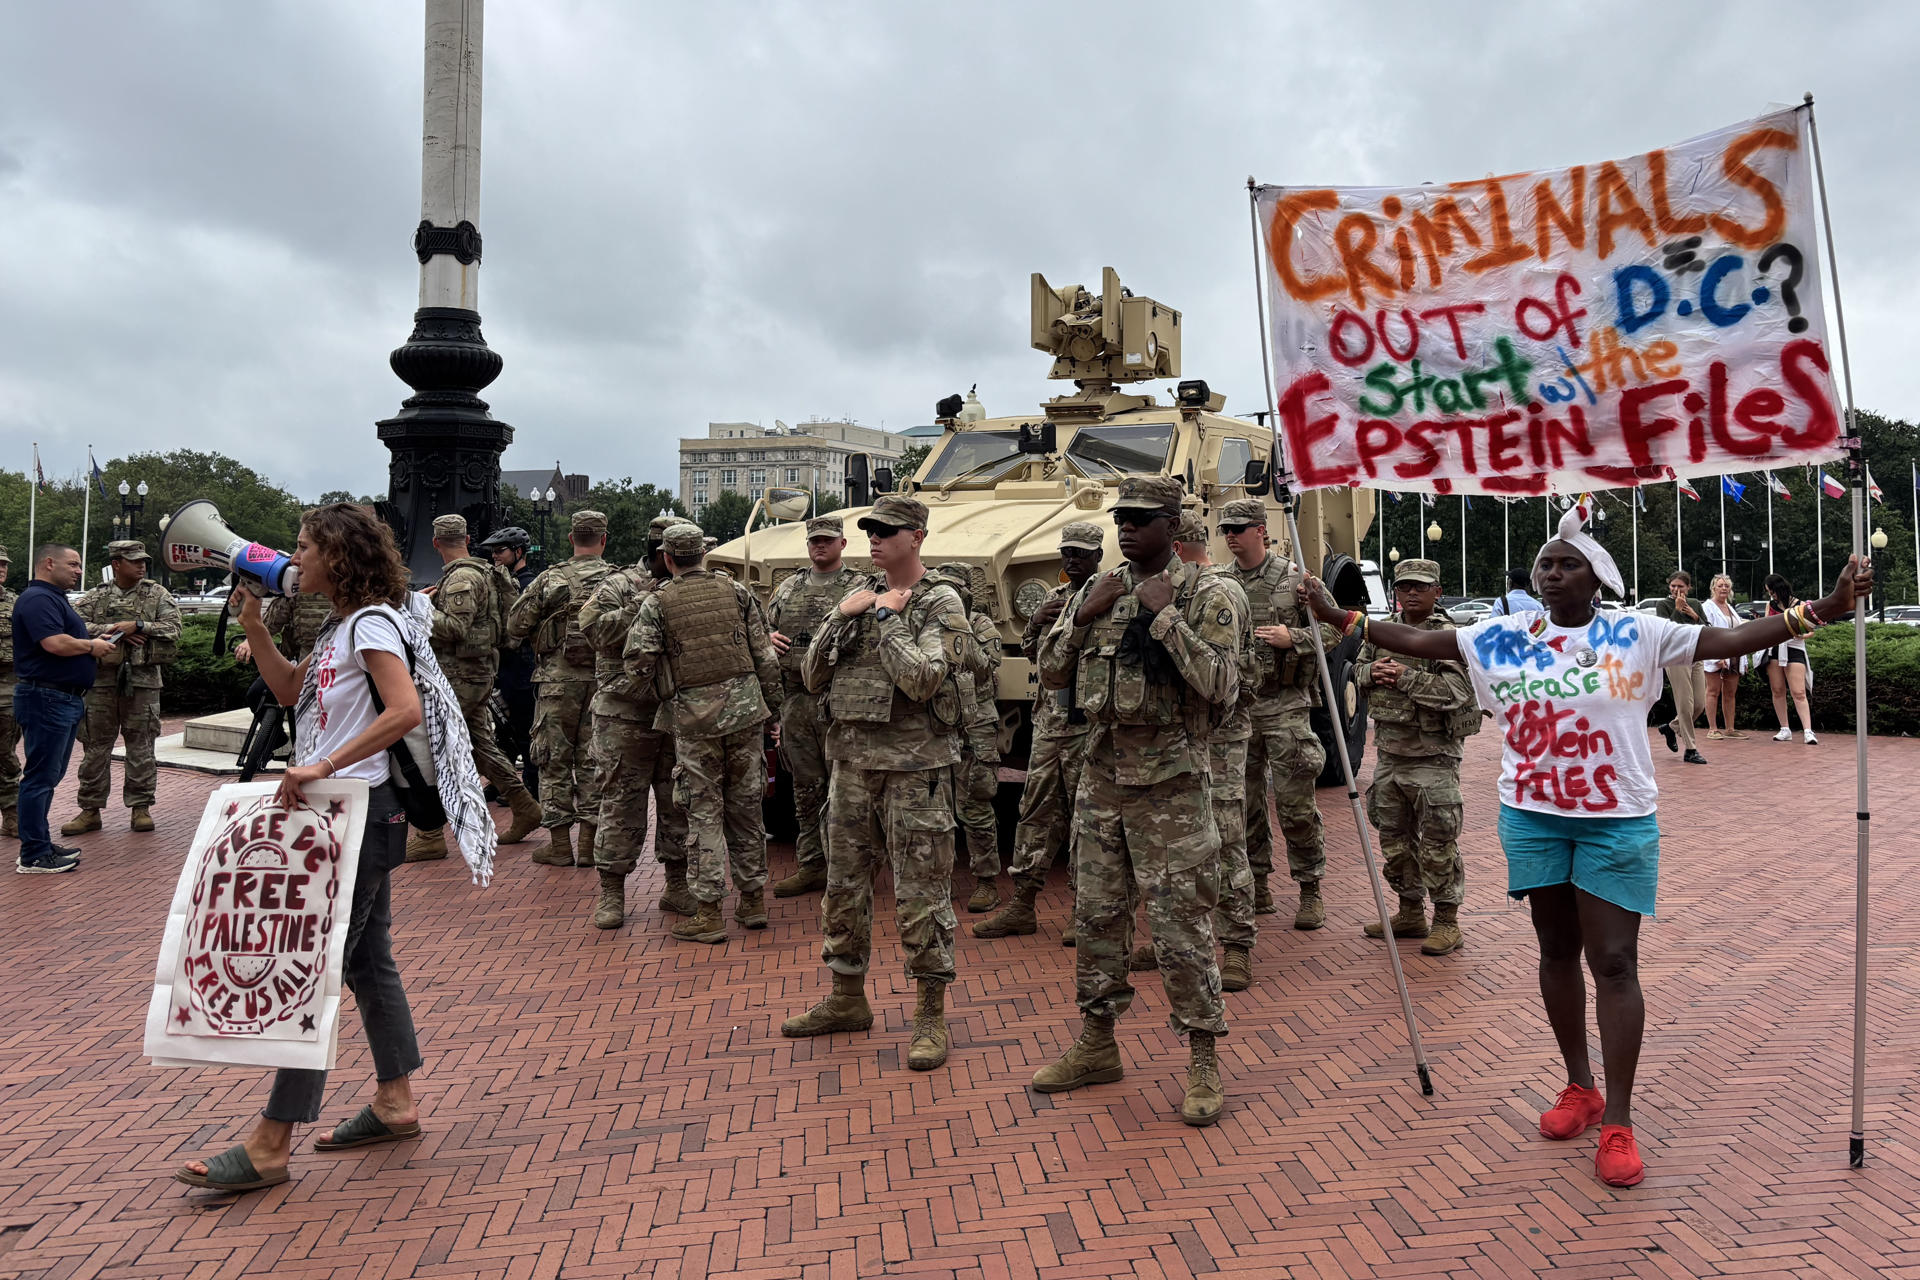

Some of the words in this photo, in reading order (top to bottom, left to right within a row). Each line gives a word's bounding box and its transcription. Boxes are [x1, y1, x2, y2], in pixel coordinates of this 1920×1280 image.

[1329, 303, 1484, 366] OUT
[1358, 336, 1534, 417] Start
[1565, 326, 1683, 394] the
[171, 544, 200, 554] FREE
[1595, 652, 1646, 702] the
[215, 813, 289, 868] FREE
[207, 871, 310, 910] FREE
[200, 912, 318, 954] PALESTINE
[194, 952, 240, 1018] FREE
[245, 986, 273, 1019] US
[272, 959, 312, 1005] ALL
